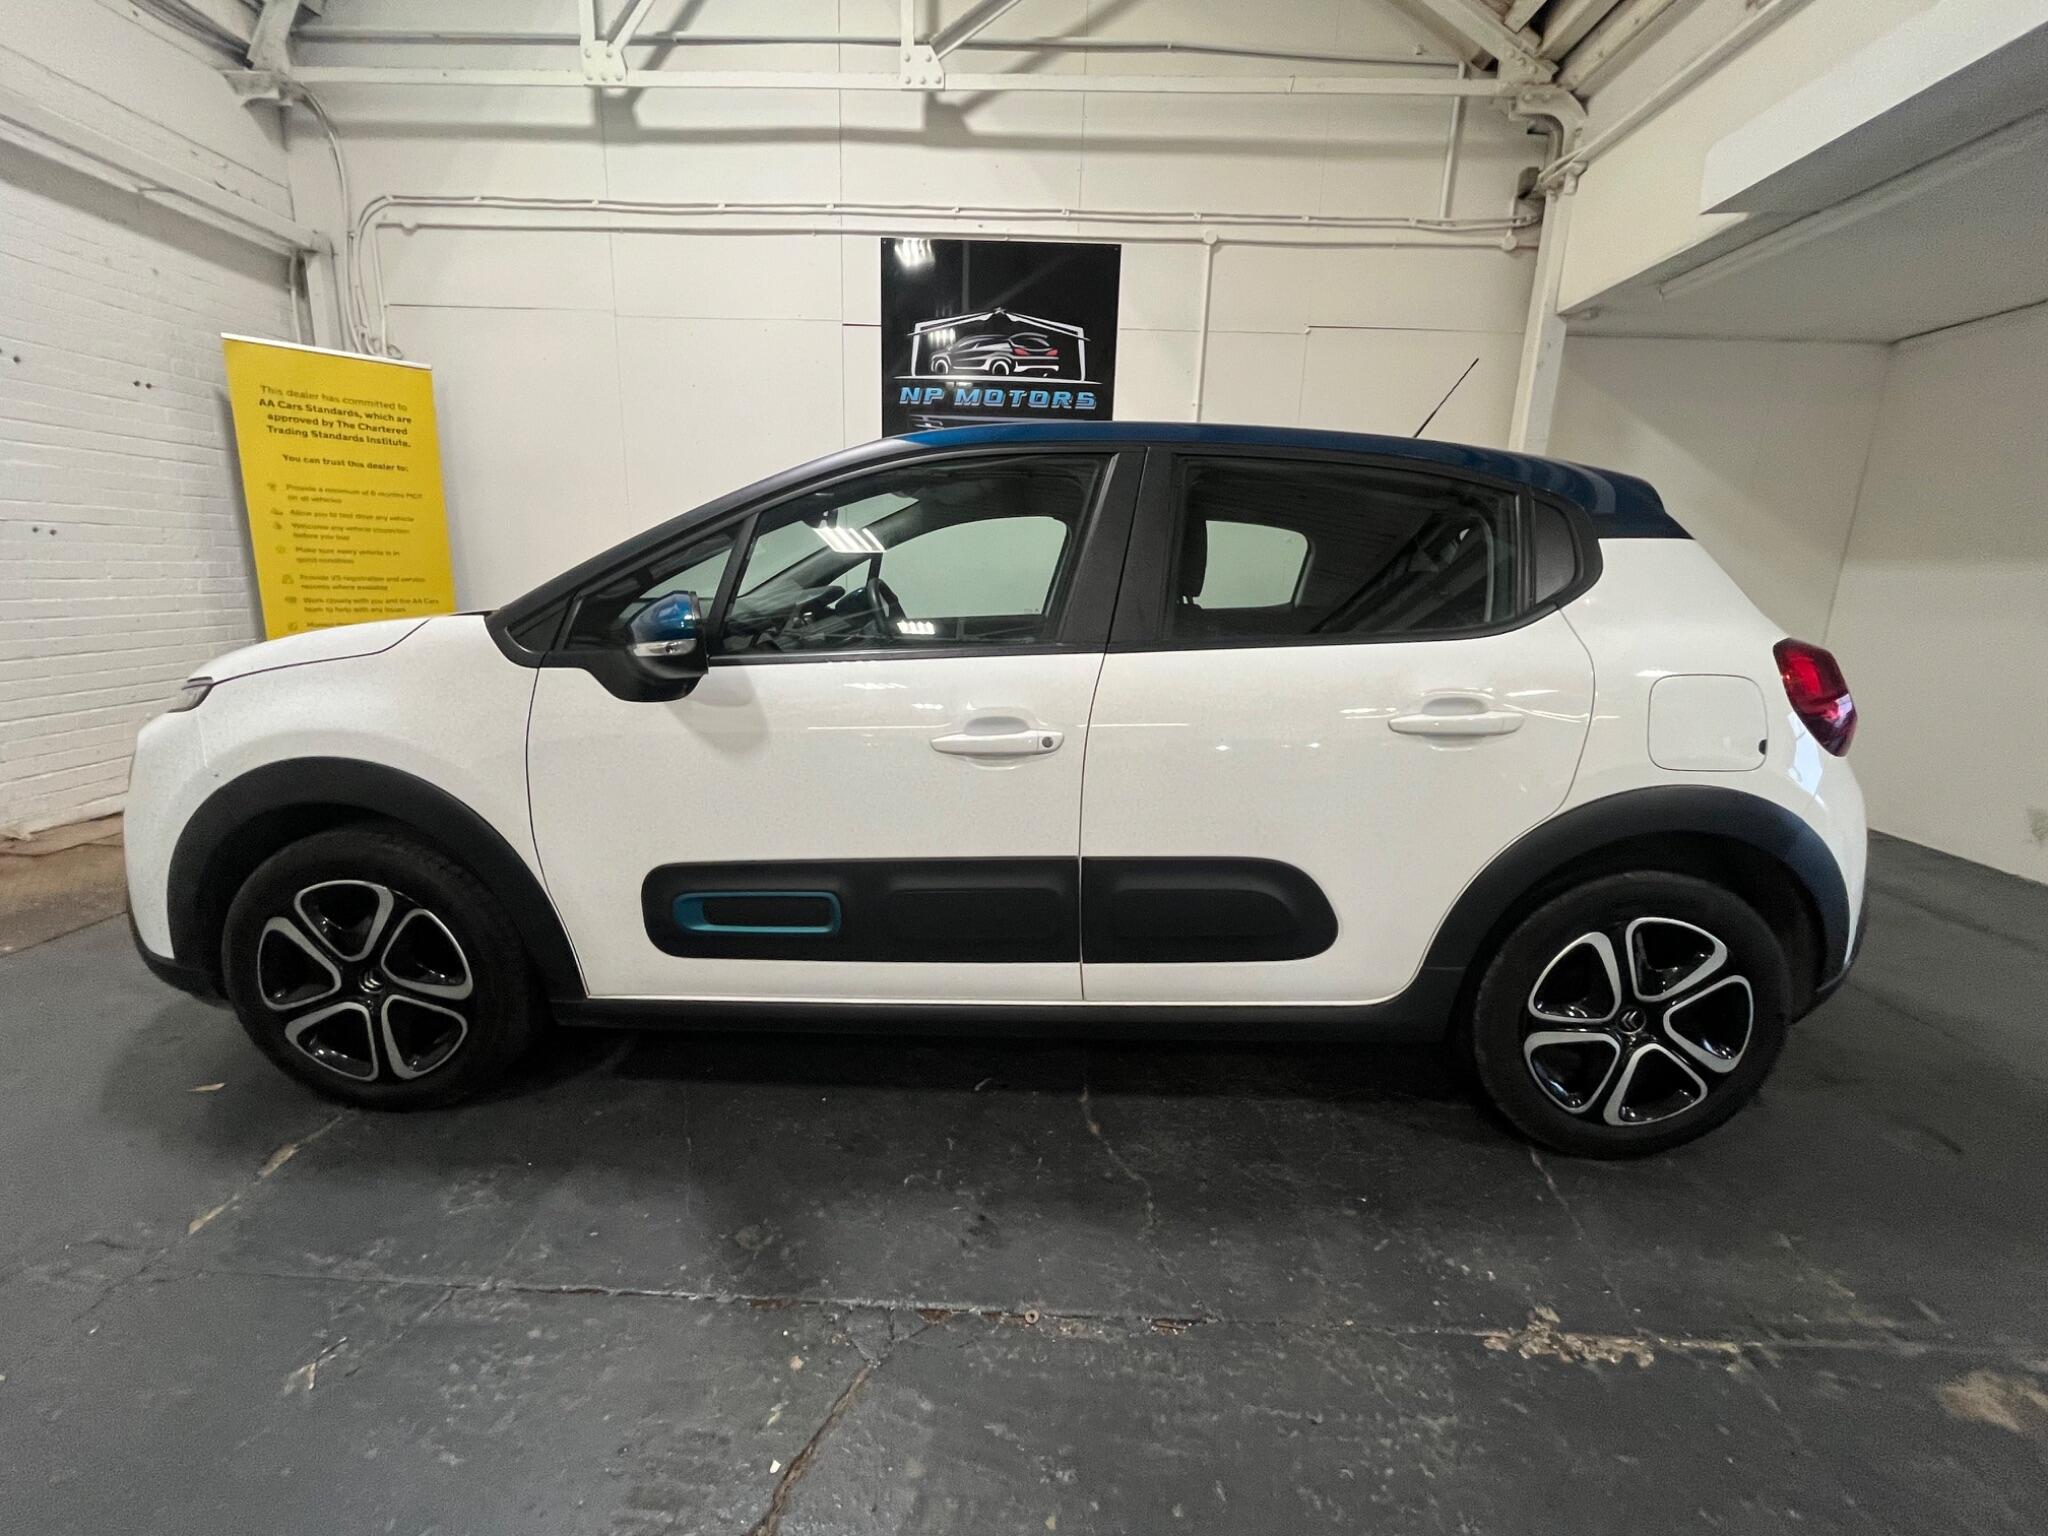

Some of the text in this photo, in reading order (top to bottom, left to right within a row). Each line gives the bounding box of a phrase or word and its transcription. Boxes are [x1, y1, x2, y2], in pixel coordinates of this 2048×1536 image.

[261, 385, 283, 396] This
[286, 389, 318, 400] dealer
[322, 393, 339, 402] has
[342, 398, 395, 409] committed
[899, 386, 1097, 410] NP MOTORS
[259, 399, 275, 407] AA
[278, 400, 303, 411] Cars
[306, 404, 362, 419] Standards,
[364, 413, 394, 422] which
[267, 425, 308, 437] Trading
[311, 431, 364, 442] Standards
[268, 414, 408, 435] approved by The Chartered
[283, 454, 300, 463] You
[323, 458, 345, 466] trust
[348, 460, 364, 468] this
[367, 463, 394, 471] dealer
